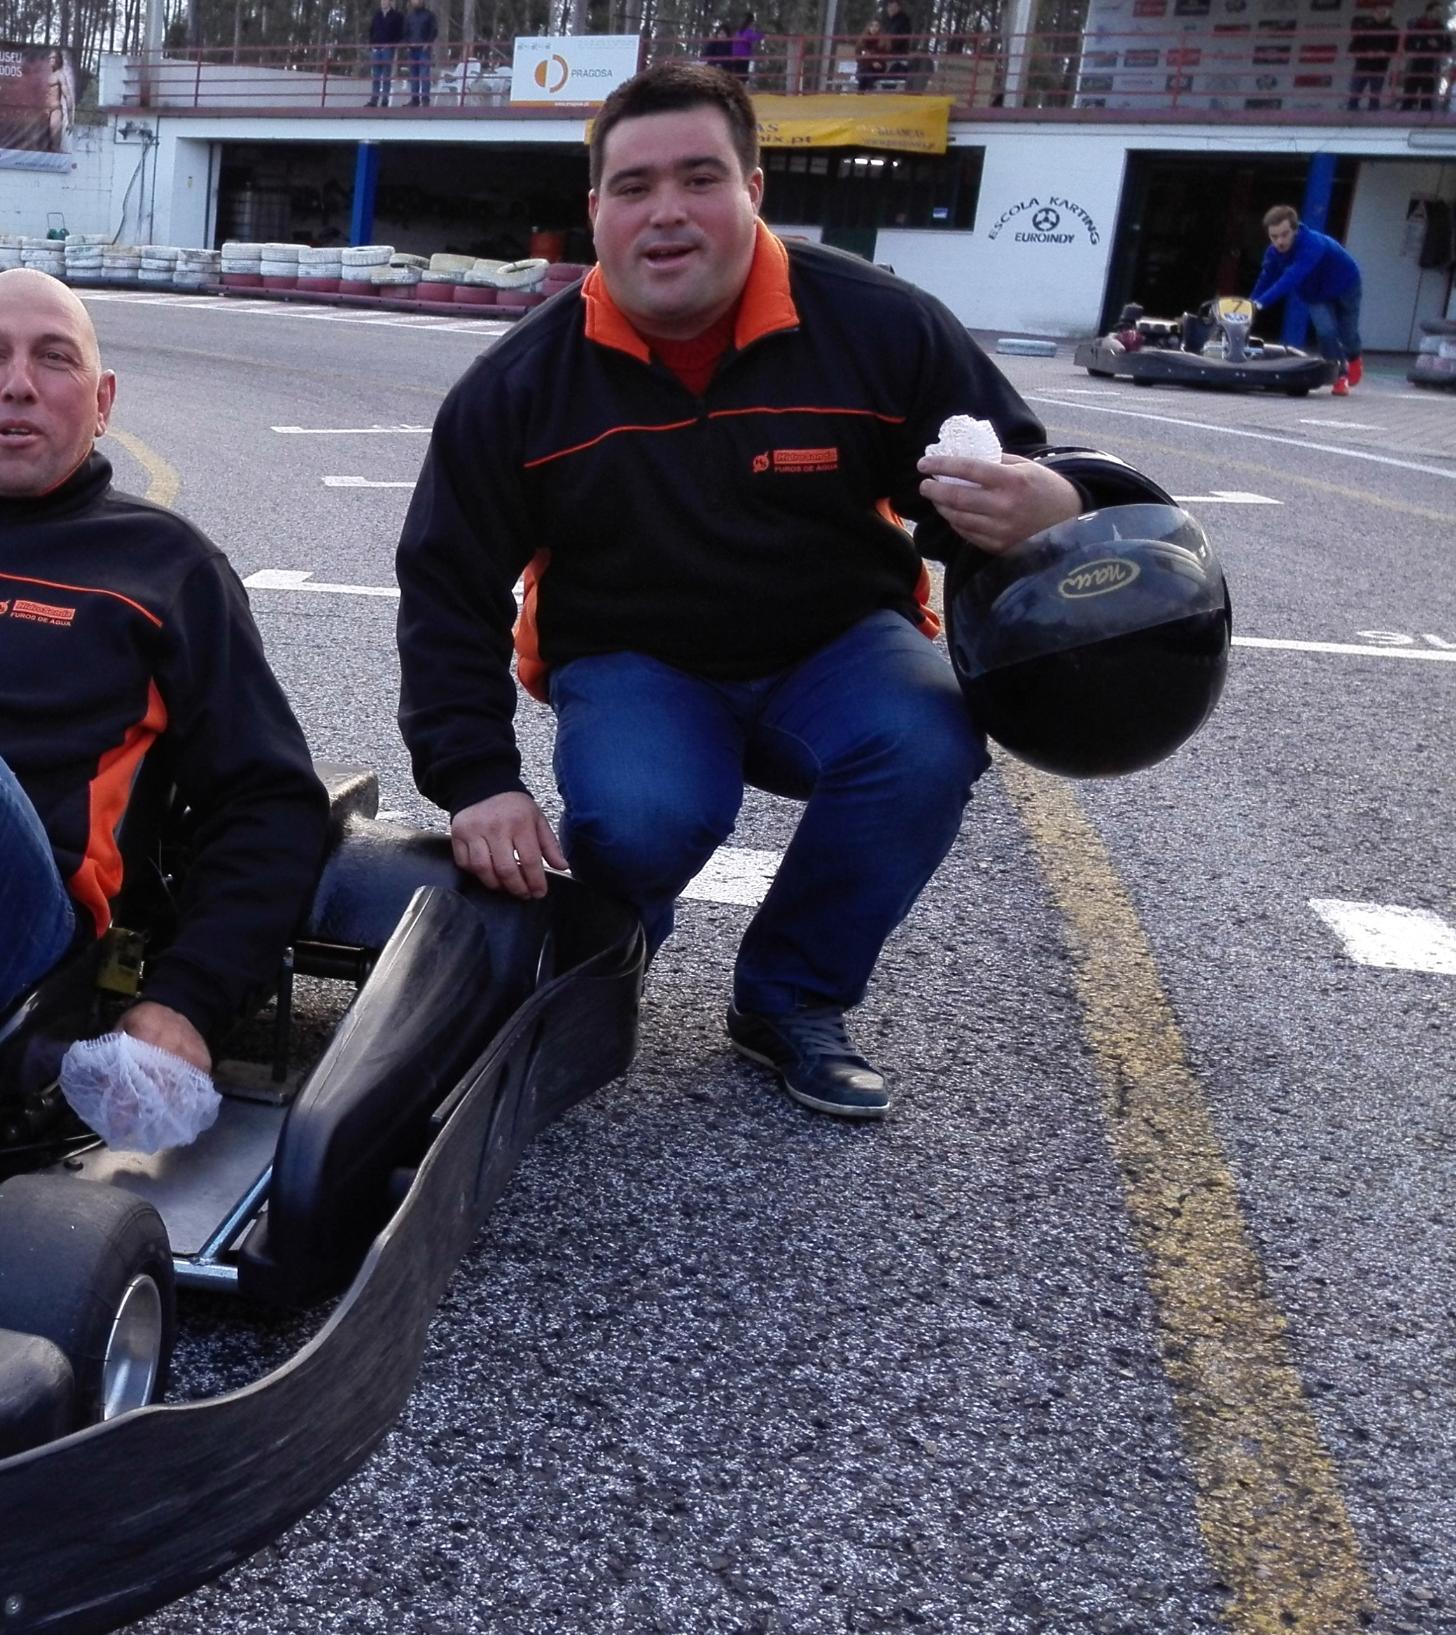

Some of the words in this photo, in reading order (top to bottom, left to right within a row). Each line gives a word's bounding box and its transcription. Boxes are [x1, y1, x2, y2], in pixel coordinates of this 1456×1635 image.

[570, 69, 613, 78] PRAGOSA
[988, 197, 1040, 241] ESCOLA
[1049, 196, 1101, 245] KARTING
[1014, 232, 1075, 244] EUROINDY
[10, 612, 37, 621] FUROS
